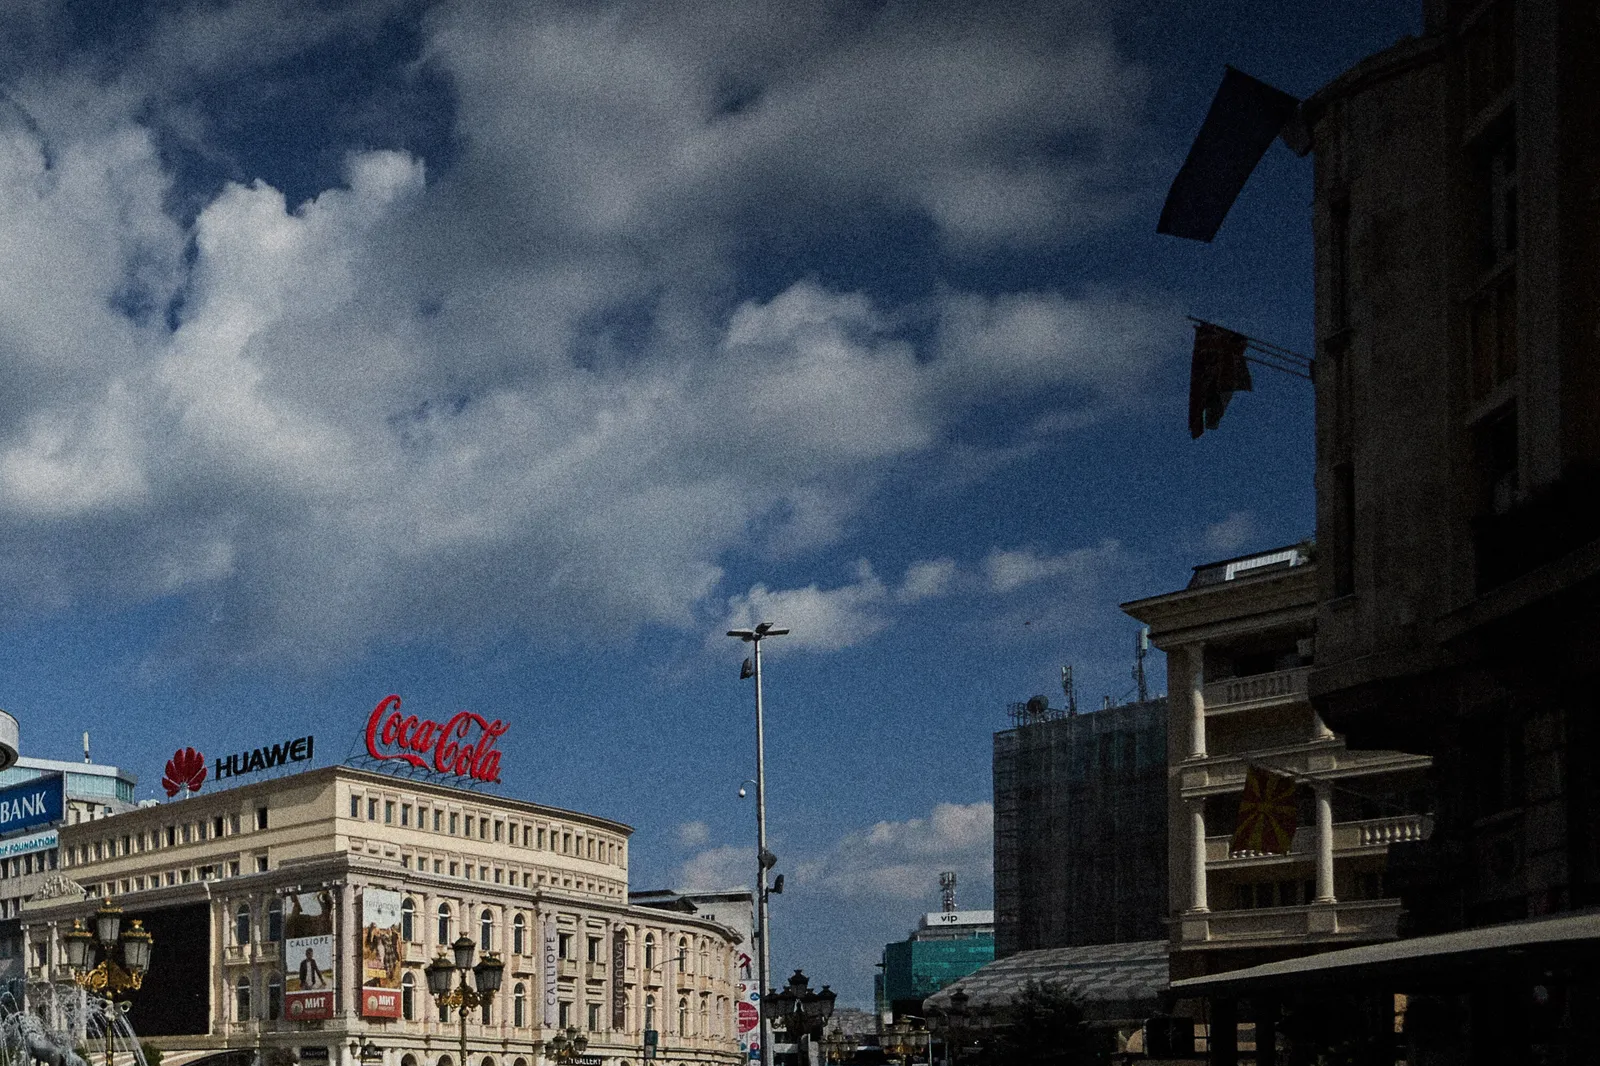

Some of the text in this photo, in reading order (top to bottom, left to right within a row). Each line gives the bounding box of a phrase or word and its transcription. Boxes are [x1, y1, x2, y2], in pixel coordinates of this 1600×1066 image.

[366, 694, 510, 784] Coca-Cola
[216, 735, 314, 780] HUAWEI
[9, 836, 56, 854] FOUNDATION
[941, 913, 958, 923] vip
[289, 936, 329, 948] CALLIOPE
[546, 936, 556, 1006] CALLIOPE
[304, 997, 326, 1009] МИТ
[378, 995, 395, 1006] МИТ
[574, 1057, 601, 1065] GALLERY
